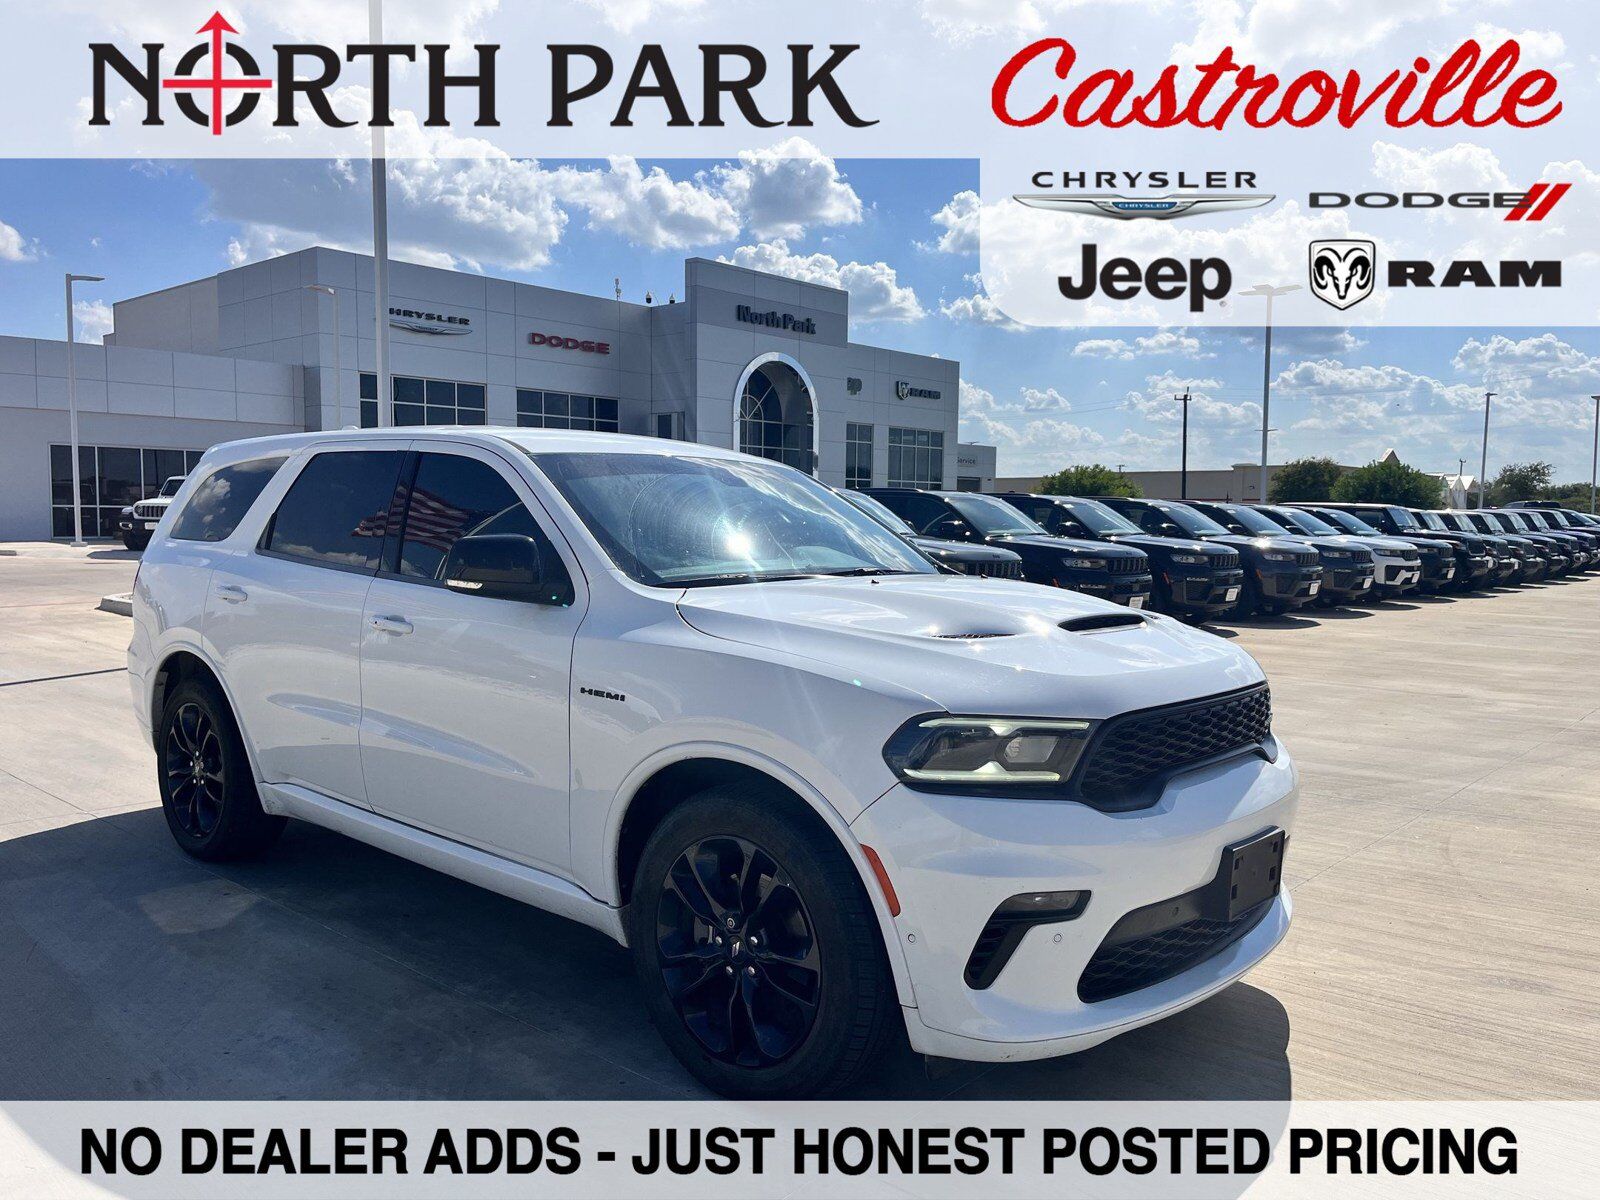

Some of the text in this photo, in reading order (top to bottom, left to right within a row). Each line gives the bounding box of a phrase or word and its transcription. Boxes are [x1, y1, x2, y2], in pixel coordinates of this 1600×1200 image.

[388, 307, 470, 325] HRYSLER
[737, 304, 816, 334] North Park
[528, 332, 610, 354] DODGE
[580, 687, 625, 701] HEMI
